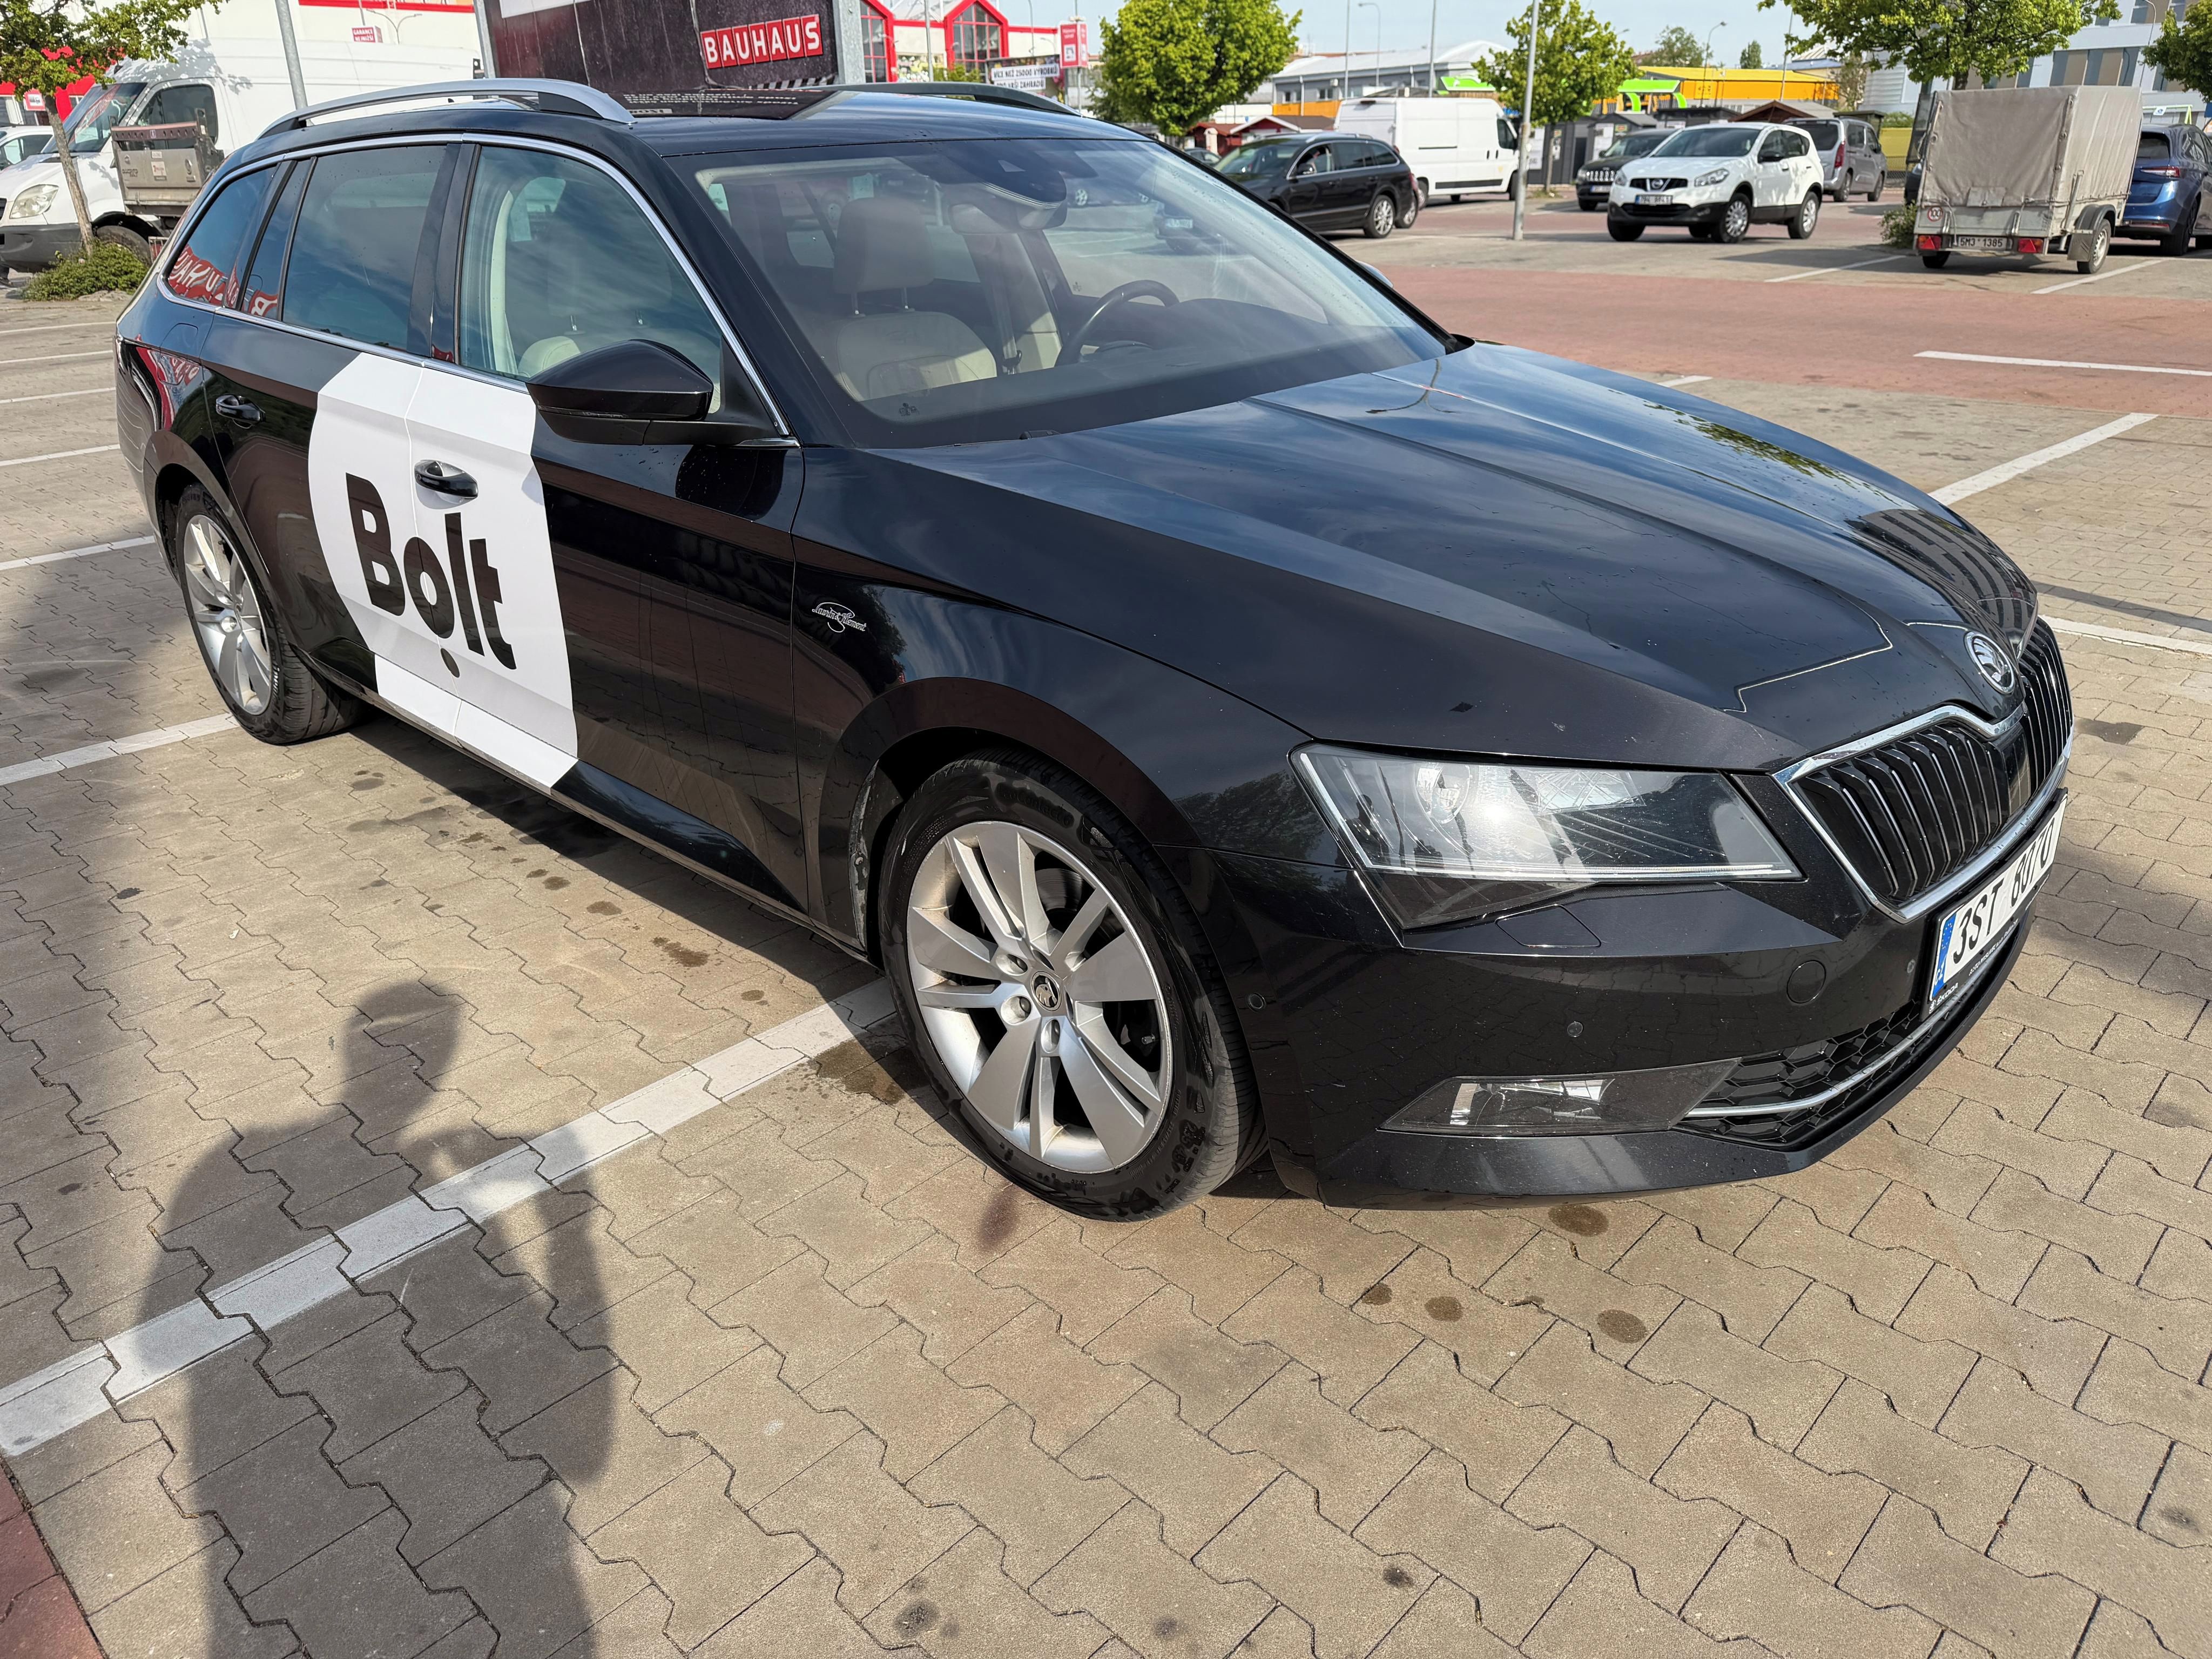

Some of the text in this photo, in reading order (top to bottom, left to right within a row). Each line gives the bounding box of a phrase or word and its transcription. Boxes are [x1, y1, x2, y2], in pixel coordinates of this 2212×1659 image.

[704, 21, 820, 63] BAUHAUS
[1960, 237, 2003, 247] 5M3 1385
[345, 472, 517, 670] Bolt
[1953, 877, 2004, 965] 3ST
[1937, 982, 1958, 1006] ŠKODA
